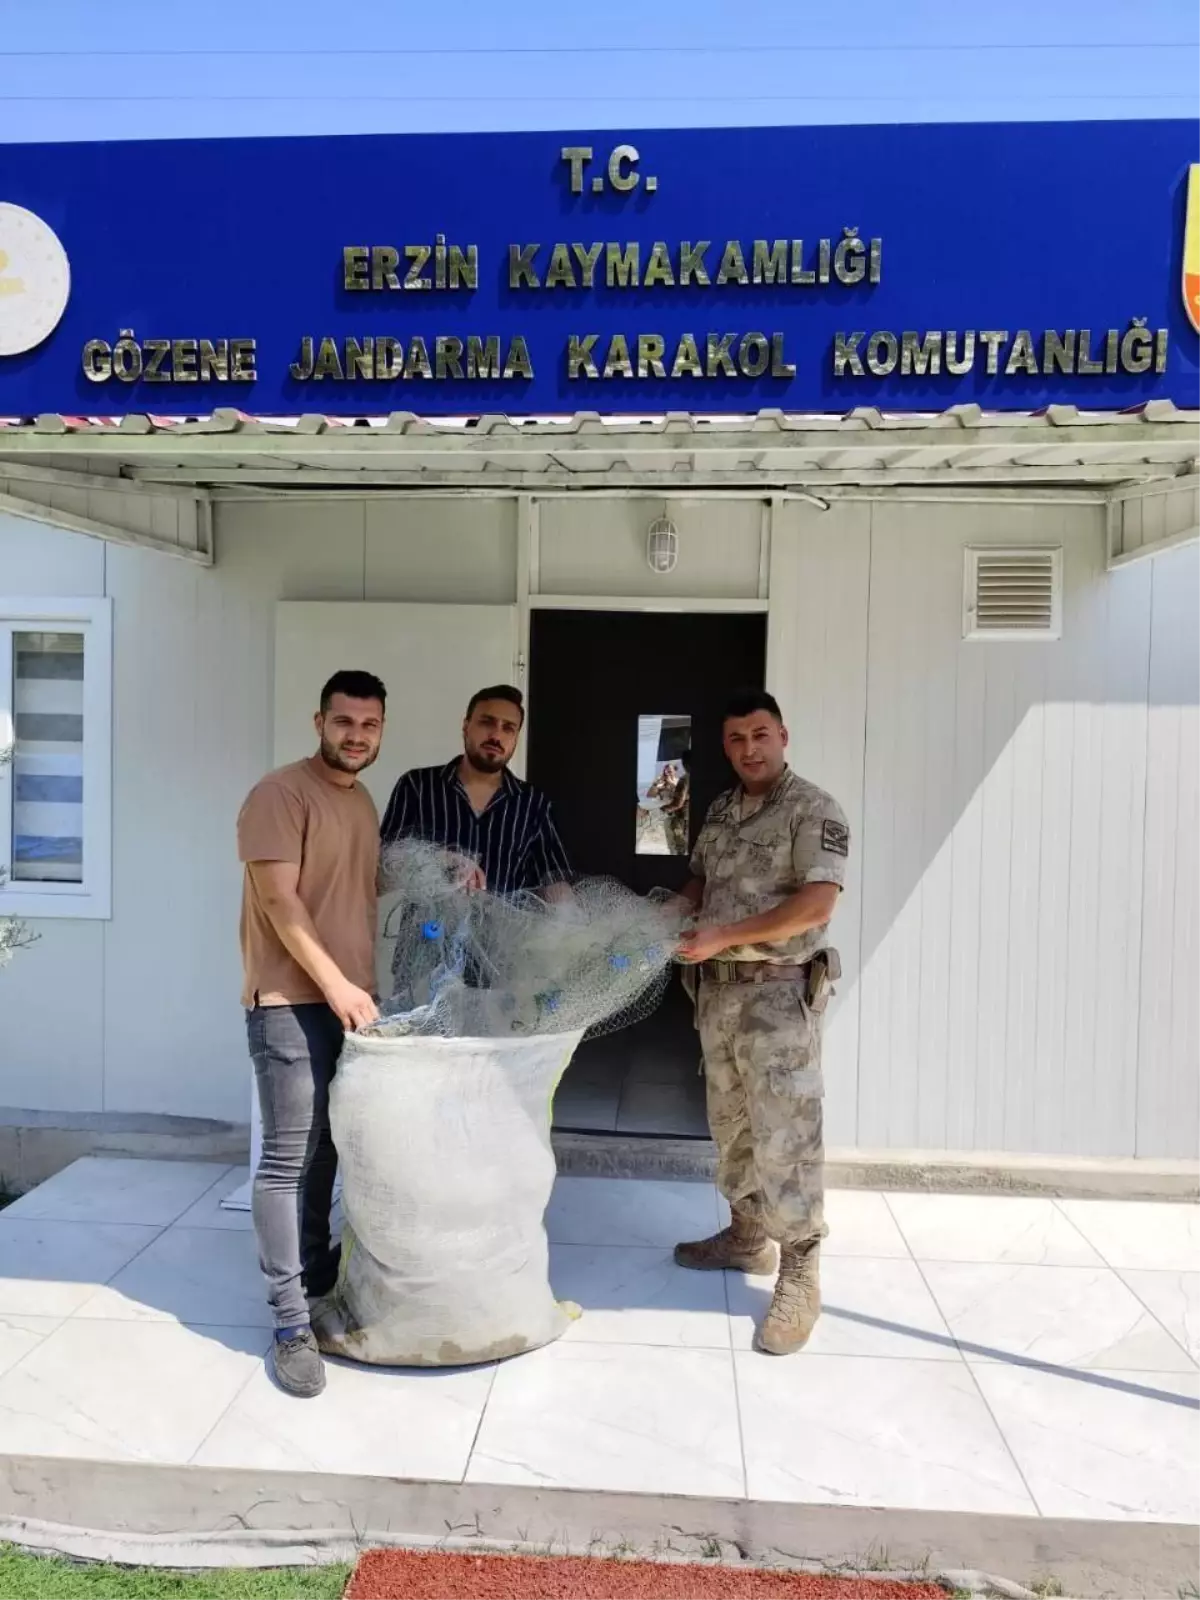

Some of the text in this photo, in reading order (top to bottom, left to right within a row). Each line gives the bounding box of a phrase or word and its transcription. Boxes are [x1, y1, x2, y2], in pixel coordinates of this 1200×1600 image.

[561, 145, 657, 192] T.C.
[343, 226, 882, 290] ERZİN KAYMAKAMLIĞI
[82, 316, 1168, 382] GÖZENE JANDARMA KARAKOL KOMUTANLIĞI
